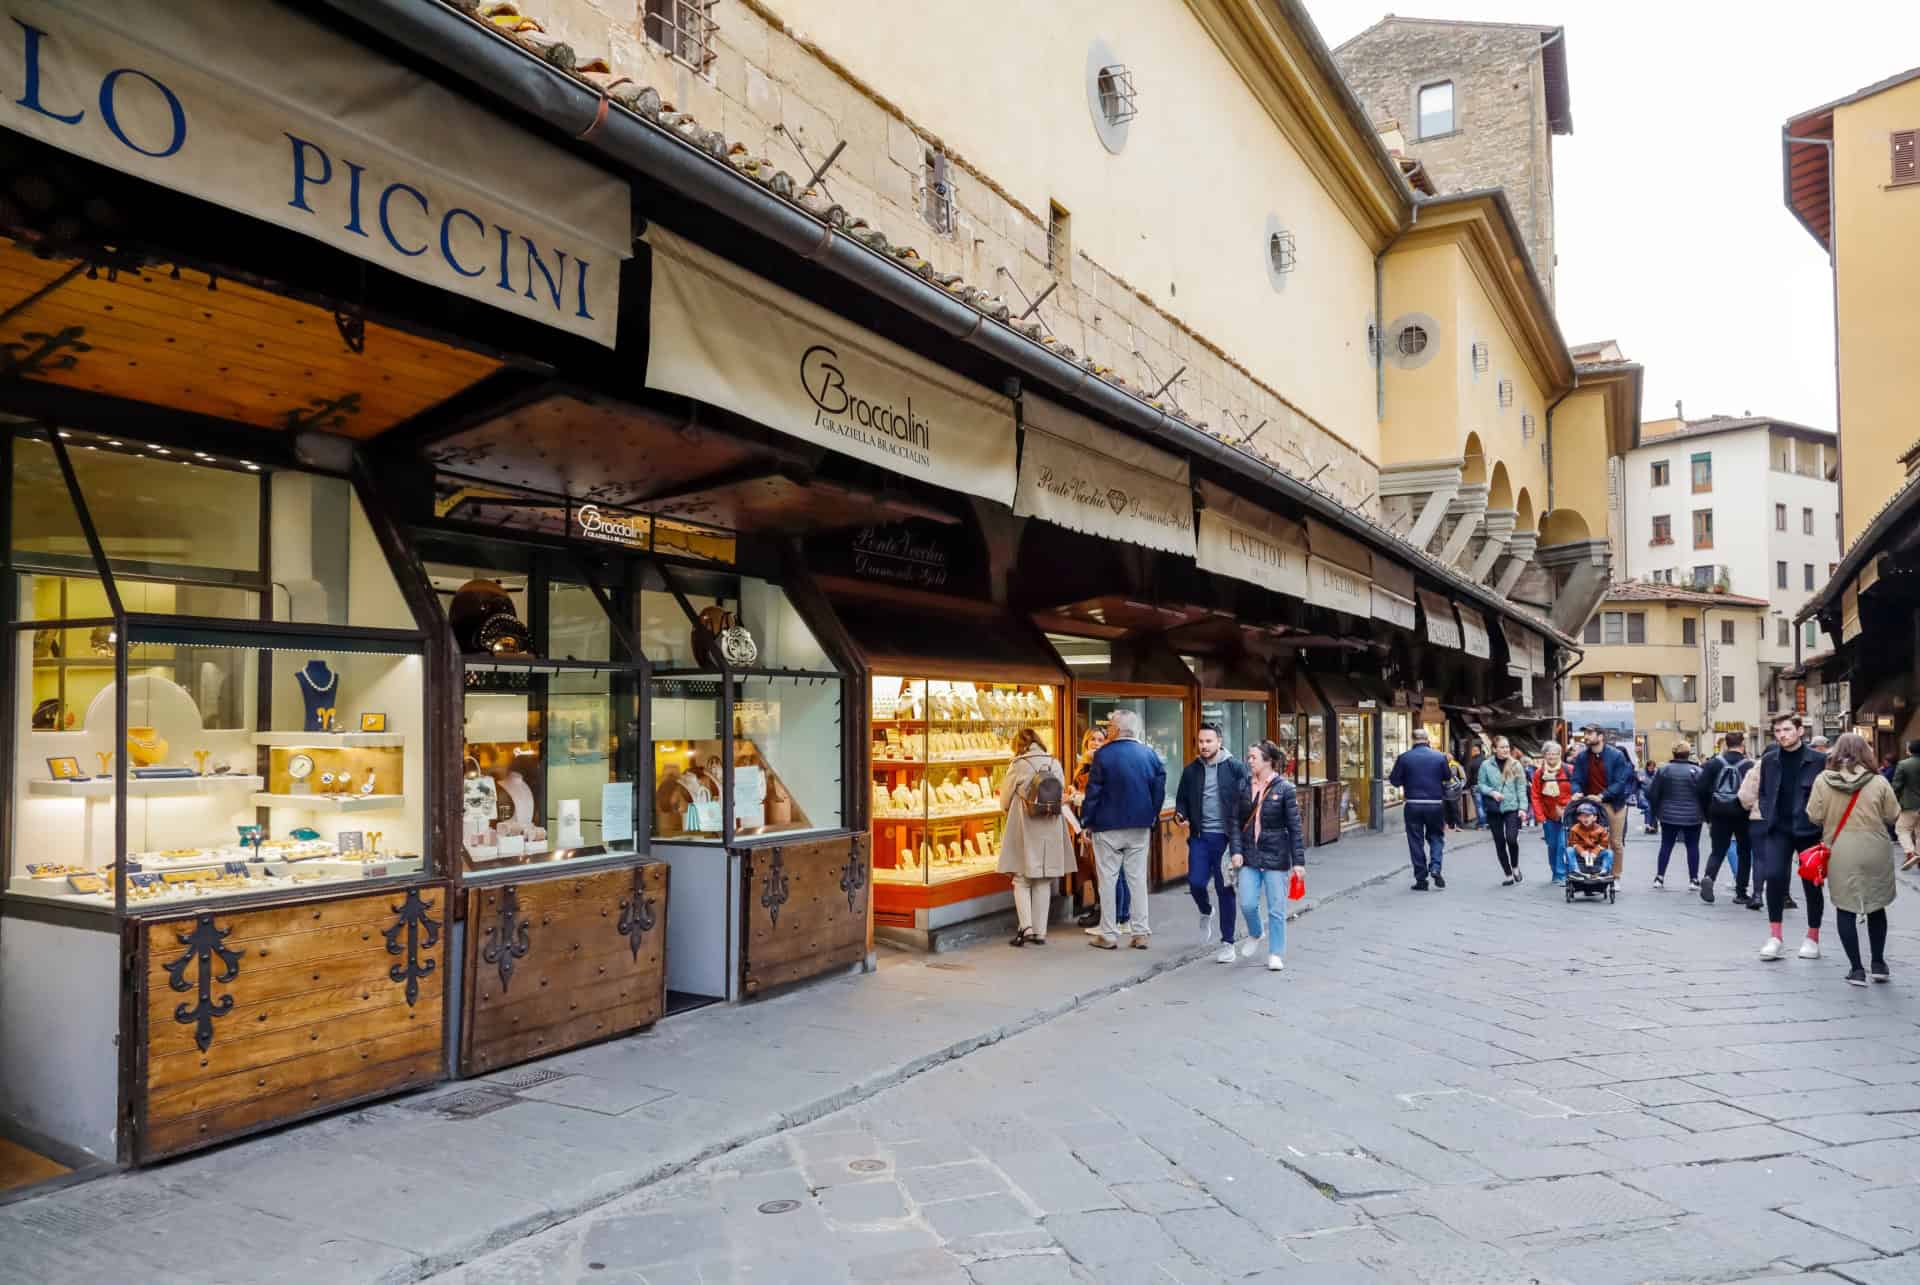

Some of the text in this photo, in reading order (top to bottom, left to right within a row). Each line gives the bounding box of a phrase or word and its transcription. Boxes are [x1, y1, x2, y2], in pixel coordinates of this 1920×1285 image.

[283, 131, 596, 321] PICCINI
[800, 345, 930, 451] Braccialini
[821, 416, 877, 448] GRAZIELLA
